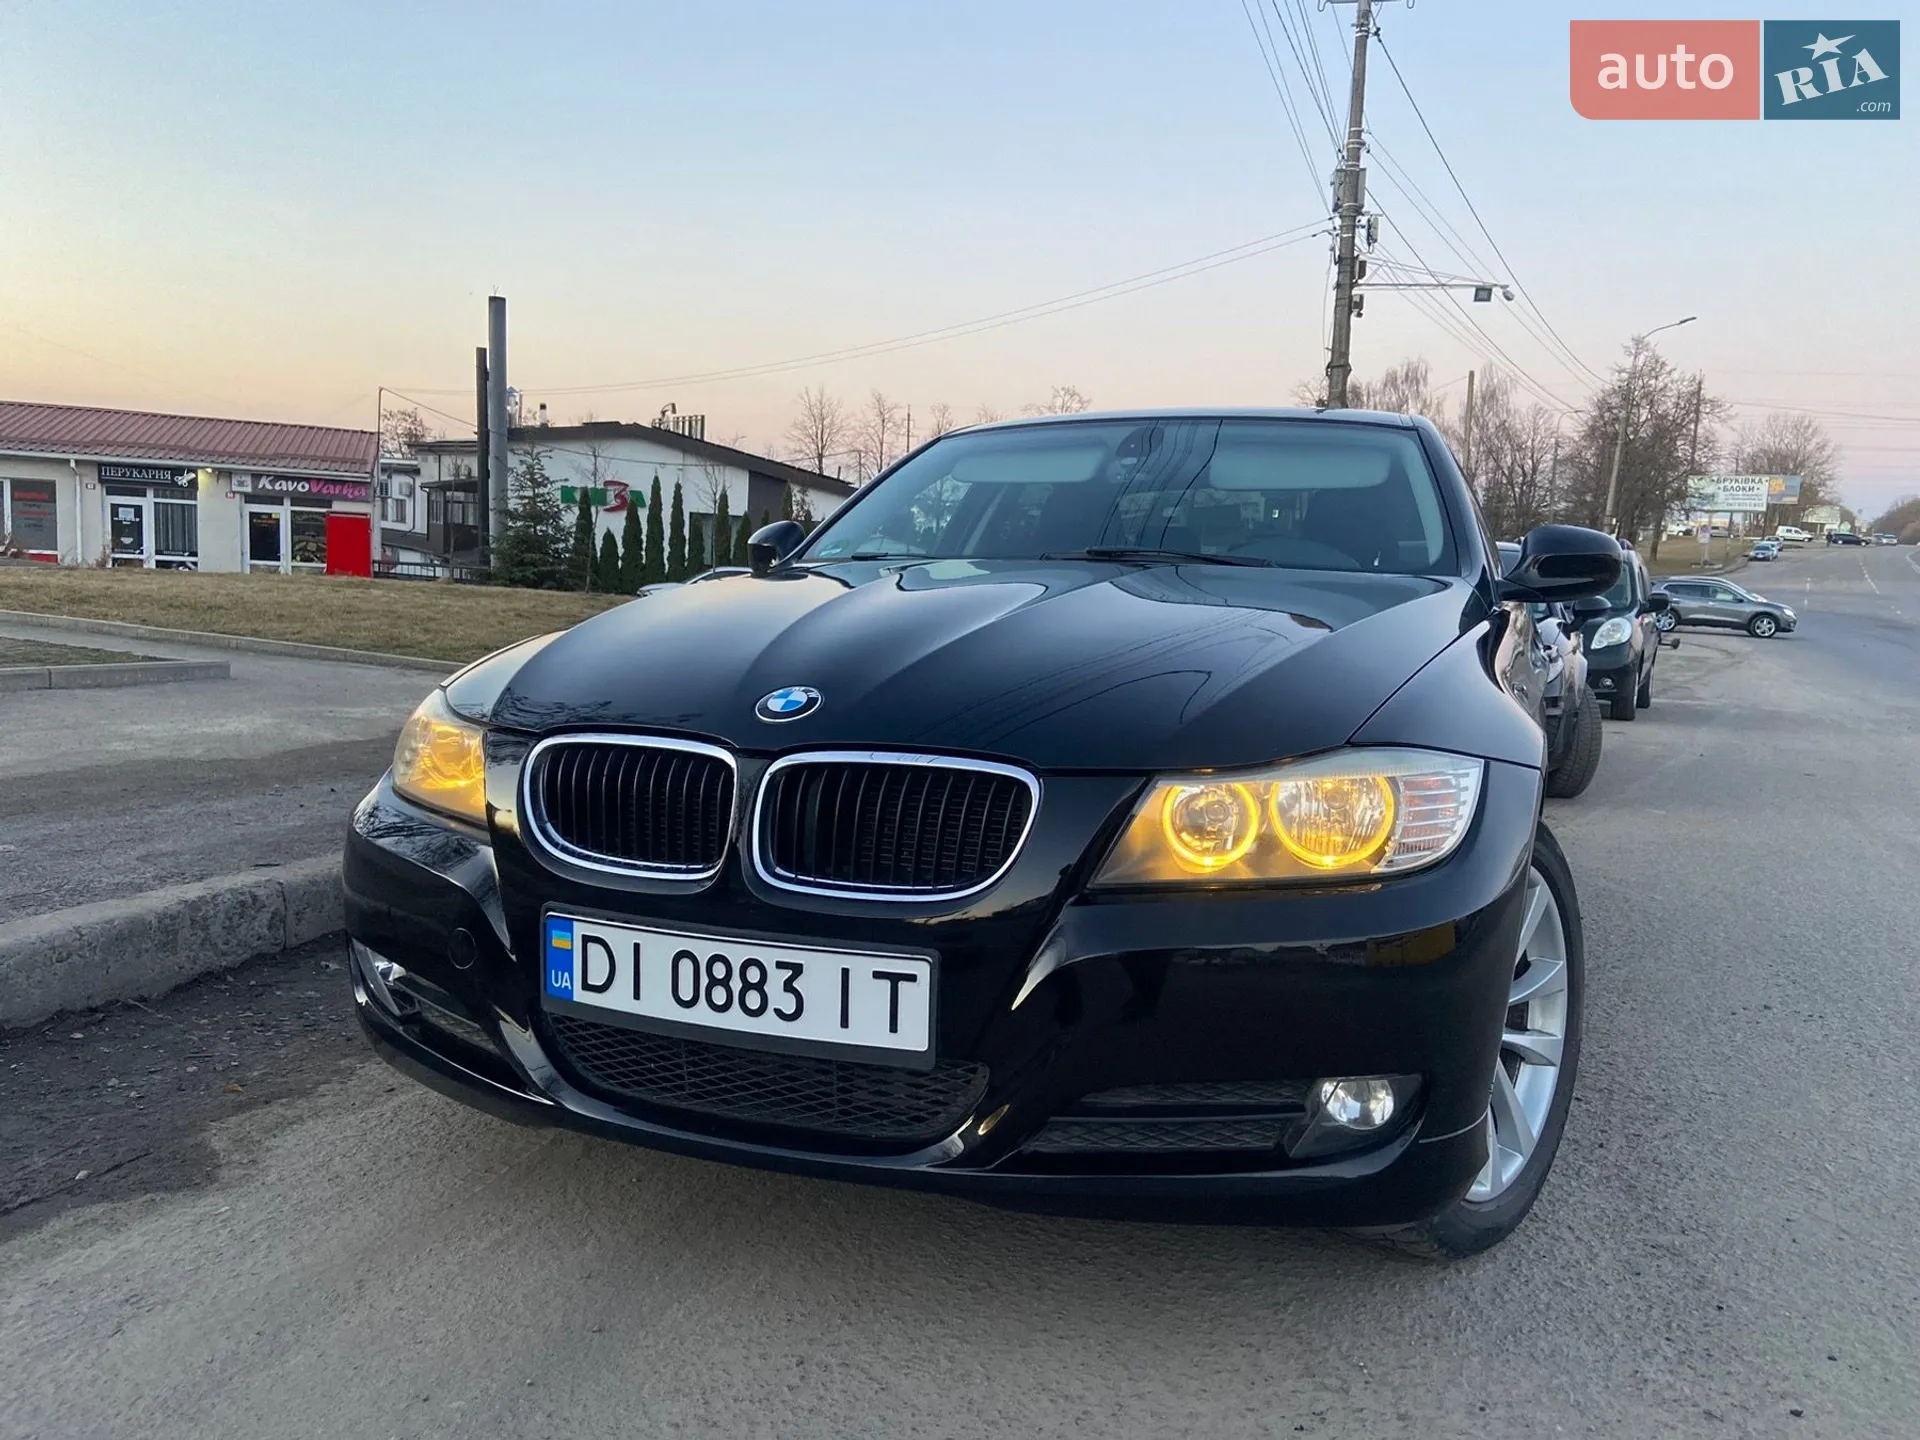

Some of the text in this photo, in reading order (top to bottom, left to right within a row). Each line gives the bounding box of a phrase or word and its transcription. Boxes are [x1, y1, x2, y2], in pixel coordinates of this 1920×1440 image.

[101, 466, 172, 480] ПЕРУКАРНЯ
[1716, 477, 1764, 485] БРУКІВКА
[1722, 485, 1755, 493] БЛОКИ
[551, 969, 572, 990] UA
[580, 933, 918, 1034] DI 0883 IT
